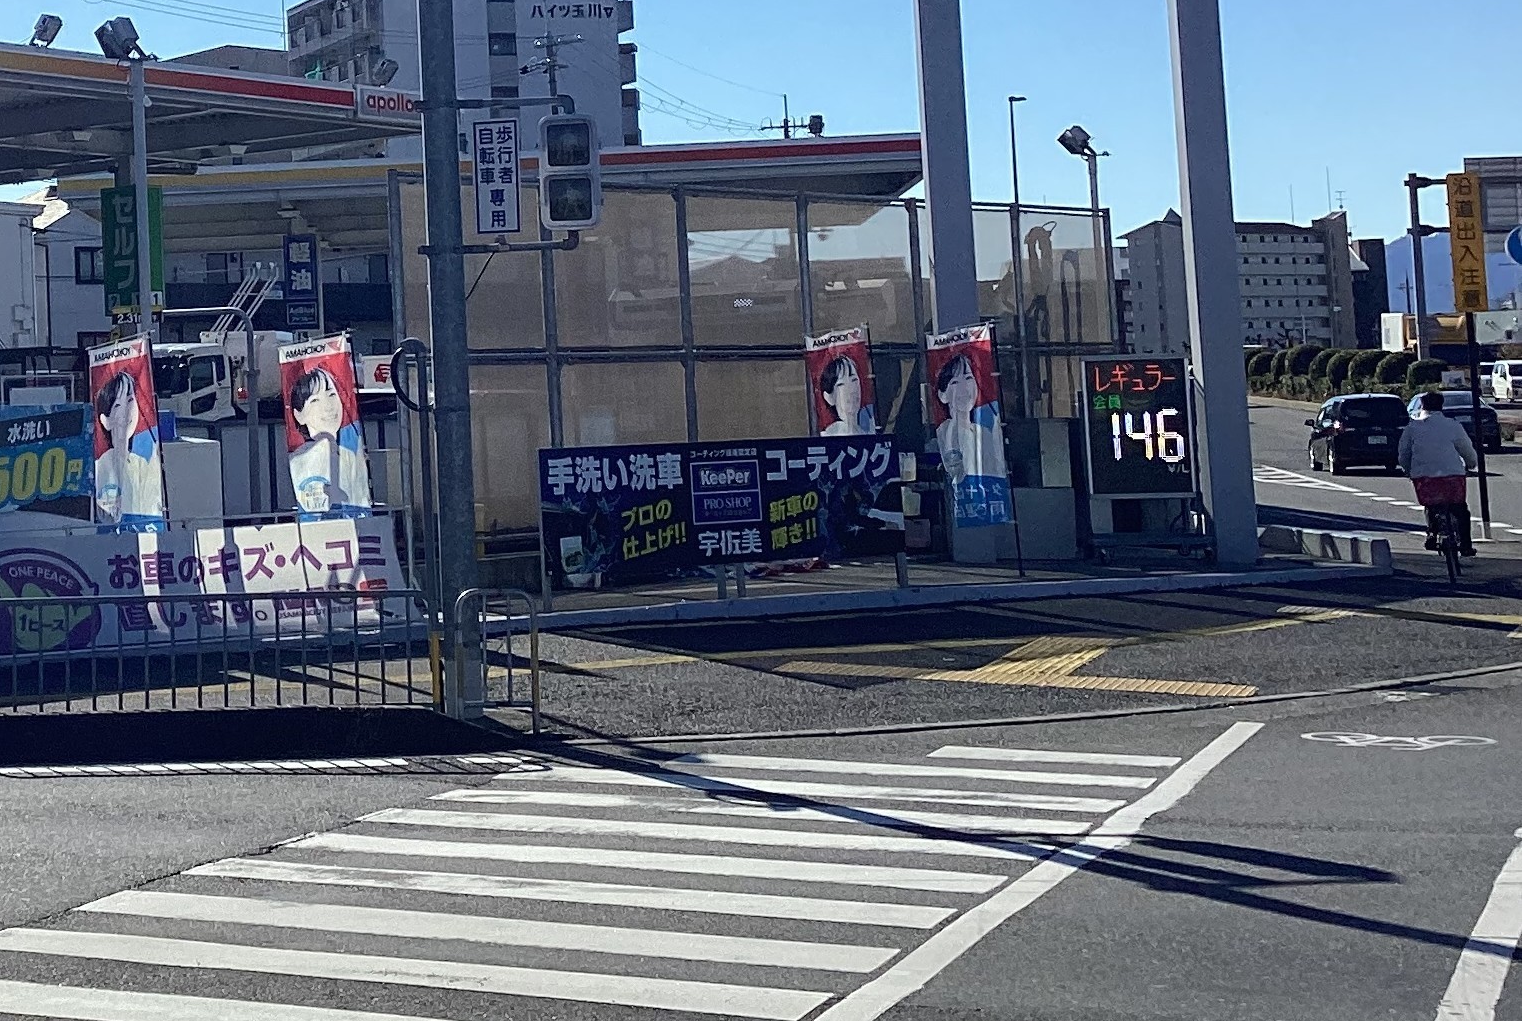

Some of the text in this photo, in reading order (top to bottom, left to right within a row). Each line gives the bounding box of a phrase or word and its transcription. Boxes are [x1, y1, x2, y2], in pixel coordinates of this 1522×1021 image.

[478, 127, 496, 185] 自転車
[495, 125, 514, 184] 歩行者
[490, 188, 506, 228] 専用
[112, 194, 135, 290] セルフ
[1094, 363, 1177, 392] レギュラー
[1092, 393, 1122, 410] 会員
[6, 420, 51, 444] 水洗い
[1110, 407, 1186, 463] 146
[547, 451, 684, 496] 手洗い洗車
[699, 467, 751, 486] KeePer
[766, 441, 892, 482] コーティング
[621, 499, 673, 533] プロの
[703, 496, 752, 510] PRO SHOP
[697, 527, 763, 558] 宇佐美
[8, 566, 75, 590] ONE PEACE
